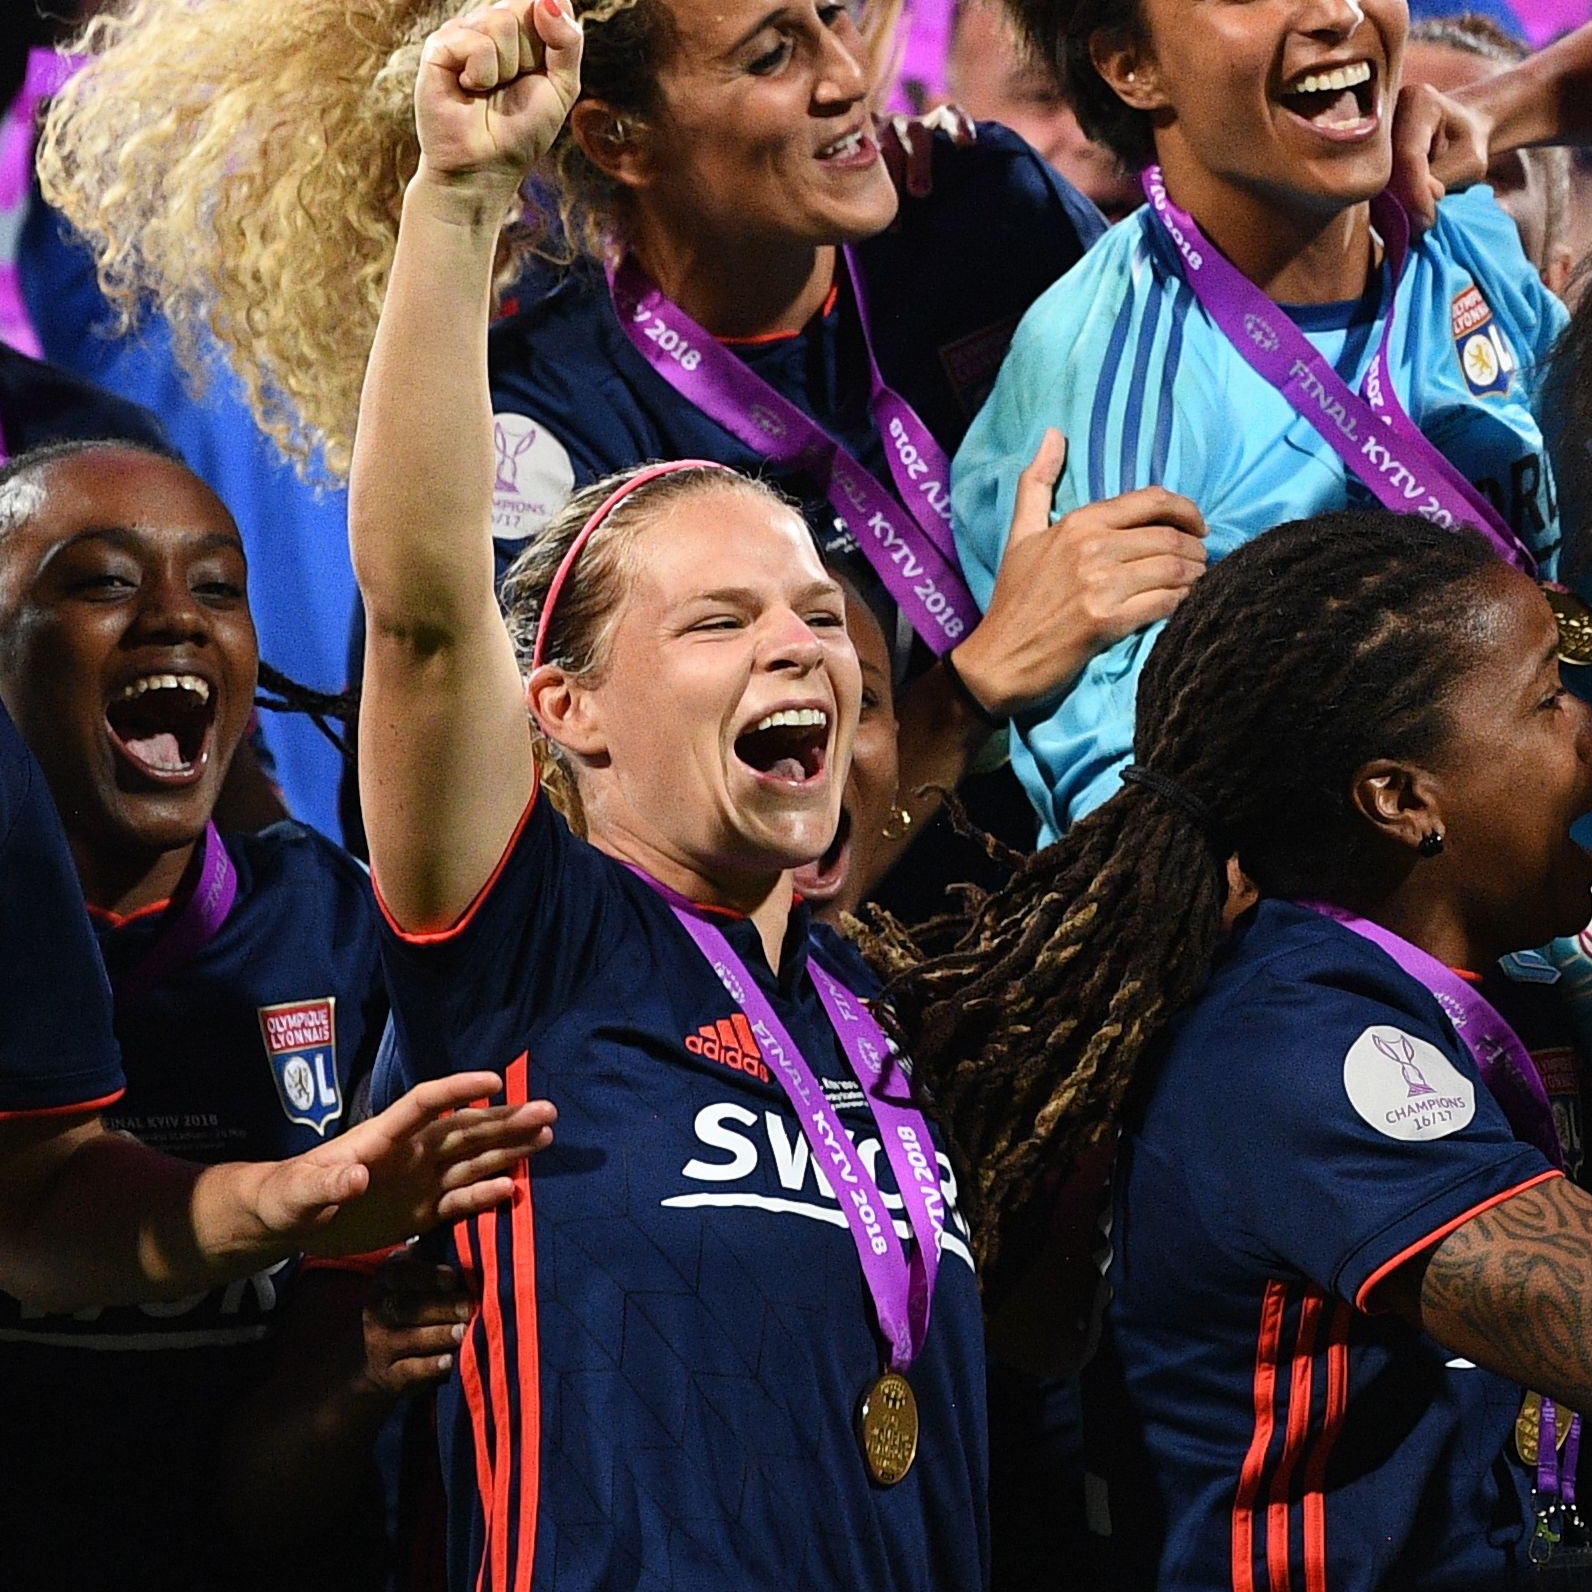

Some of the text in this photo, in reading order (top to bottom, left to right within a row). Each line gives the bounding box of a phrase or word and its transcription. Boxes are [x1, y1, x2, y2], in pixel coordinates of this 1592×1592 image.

[643, 318, 703, 371] 2018
[1463, 323, 1514, 386] OL
[888, 416, 931, 481] 2018
[1288, 358, 1359, 443] FINAL
[1361, 434, 1427, 501] KYIV
[867, 511, 965, 640] KYIV 2018
[266, 1008, 329, 1035] OLYMPIQUE
[270, 1024, 331, 1050] LYONNAIS
[282, 1053, 337, 1112] OL
[684, 1034, 770, 1084] adidas
[751, 1019, 811, 1106] FINAL
[811, 1109, 858, 1185] KYIV
[850, 1188, 889, 1256] 2018
[1385, 1097, 1467, 1125] CHAMPIONS
[1413, 1109, 1453, 1132] 16/17
[896, 1125, 935, 1183] 2018
